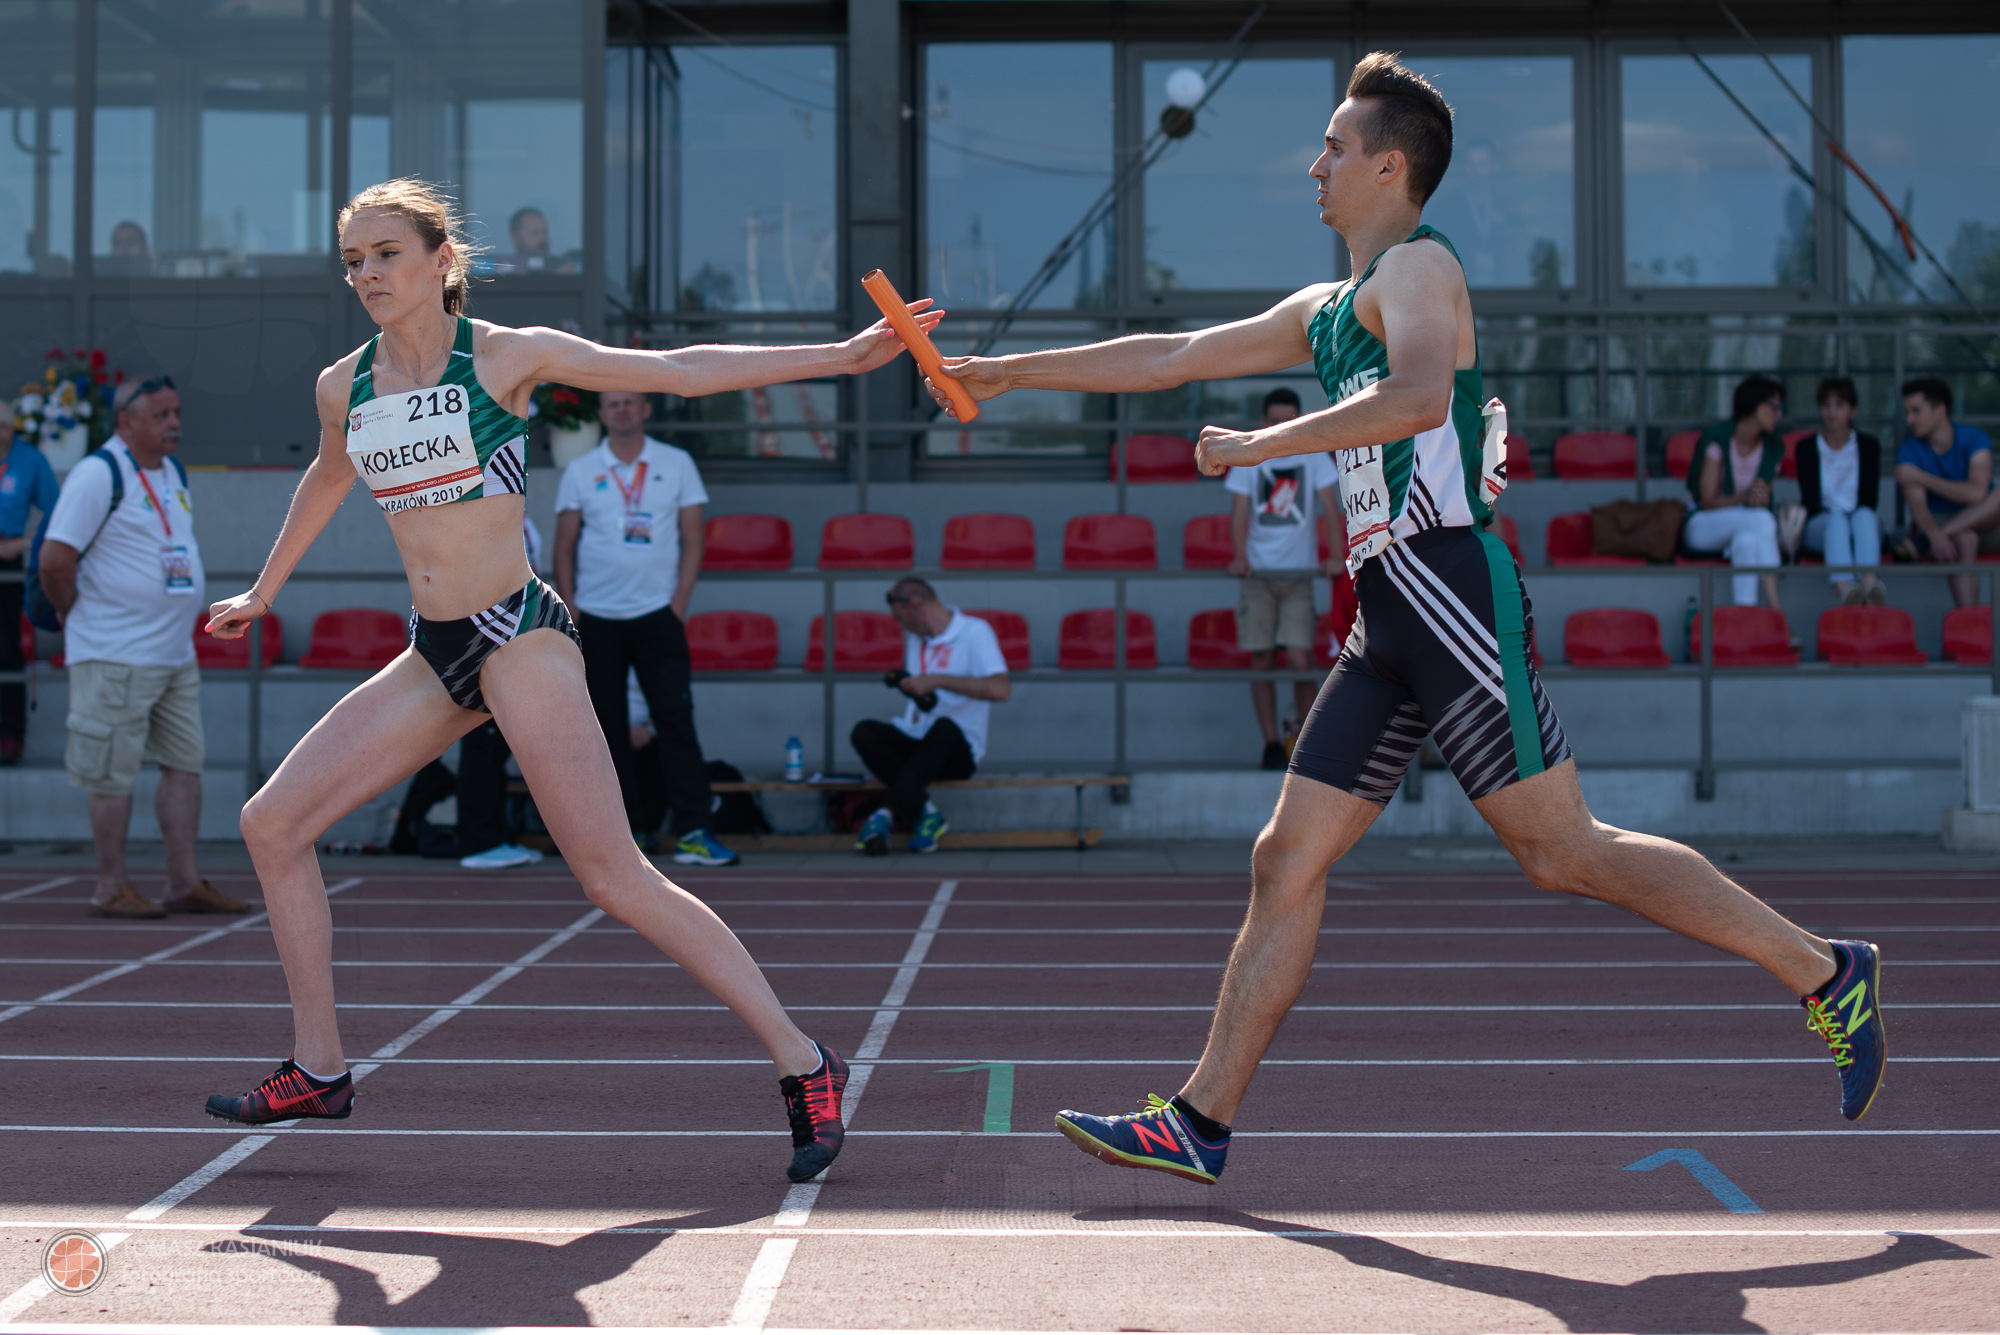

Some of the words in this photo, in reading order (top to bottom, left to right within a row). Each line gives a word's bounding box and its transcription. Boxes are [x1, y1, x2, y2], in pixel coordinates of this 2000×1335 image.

[406, 387, 463, 422] 218
[361, 435, 461, 475] KOŁECKA
[1342, 446, 1377, 475] 211
[385, 494, 428, 513] KRAKÓW
[431, 485, 463, 504] 2019
[1344, 488, 1380, 525] YKA
[1131, 1120, 1181, 1154] N
